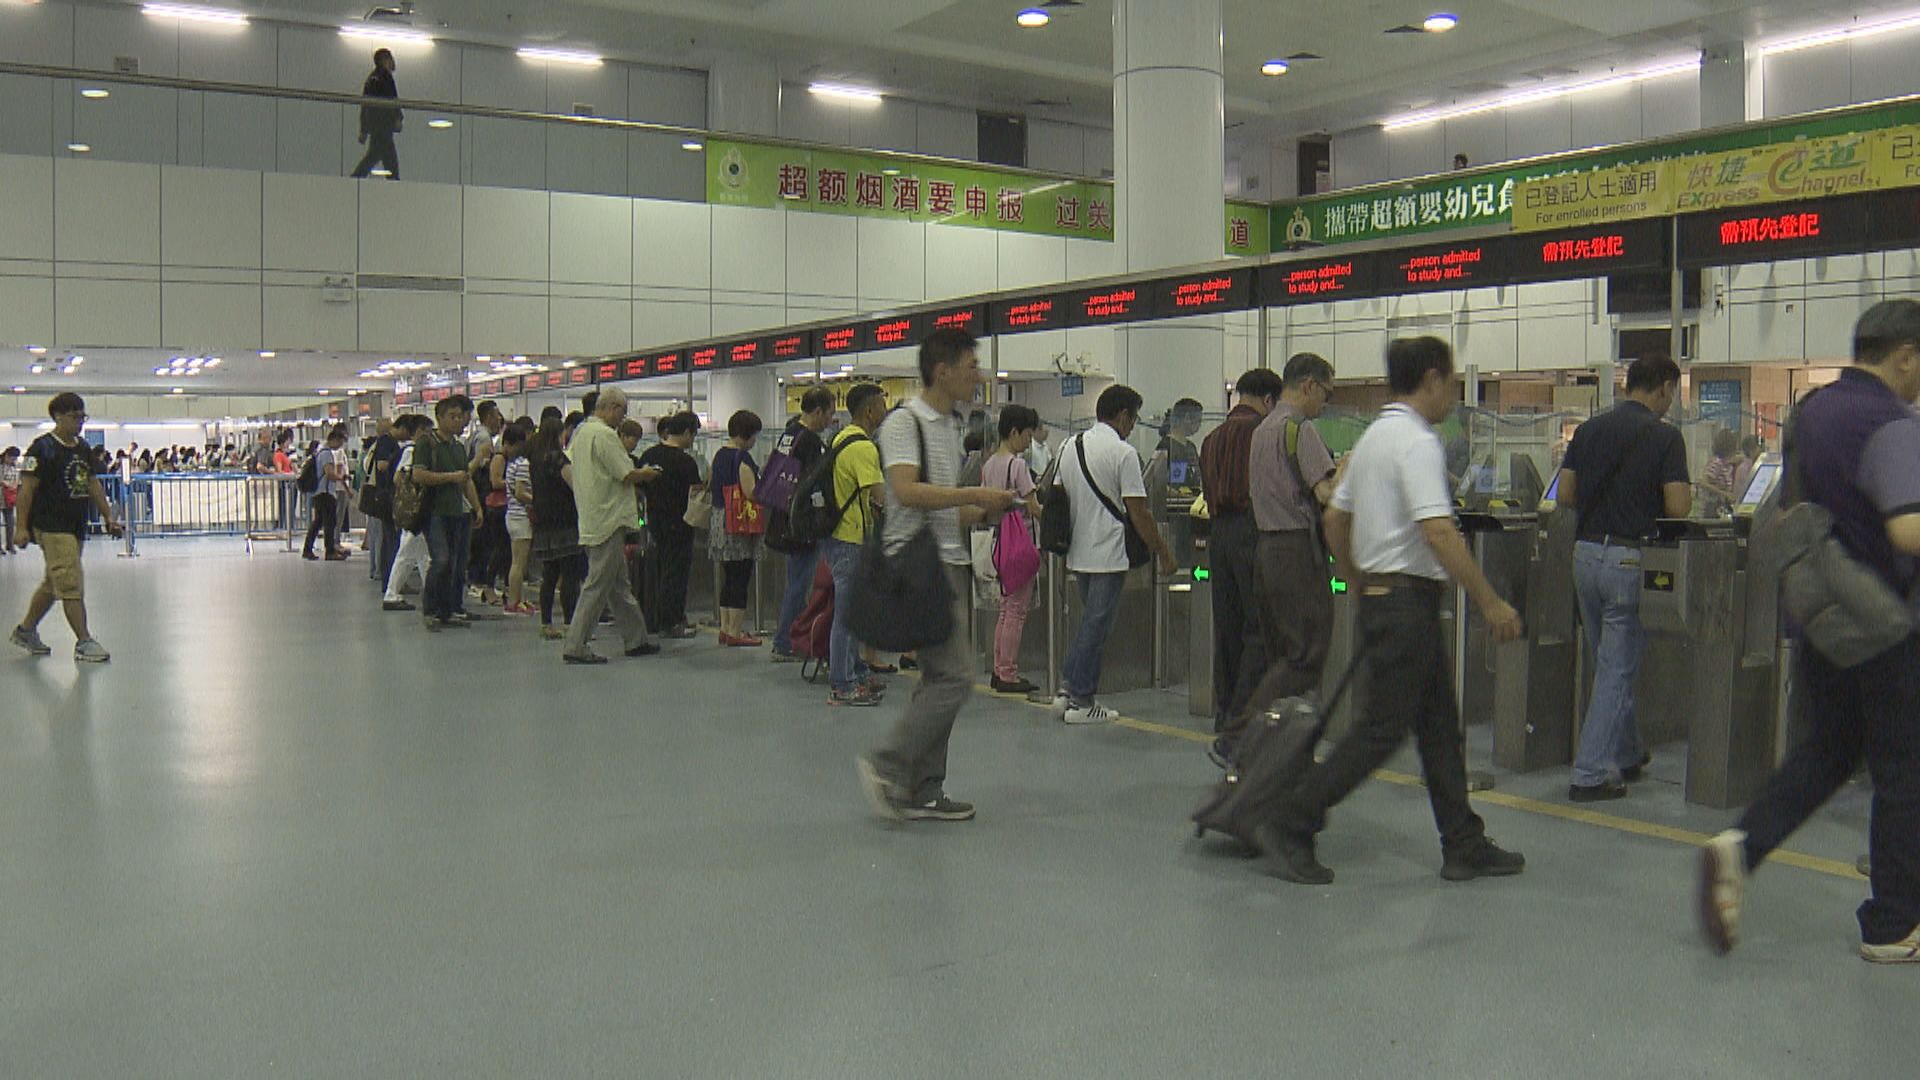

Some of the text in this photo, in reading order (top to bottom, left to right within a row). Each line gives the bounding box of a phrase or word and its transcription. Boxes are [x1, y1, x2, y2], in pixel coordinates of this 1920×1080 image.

[1892, 135, 1920, 160] 已
[1688, 156, 1747, 190] 快捷
[1525, 170, 1657, 209] 已登記人士適用
[778, 163, 1250, 248] 超额烟酒要申报 过关 道
[1536, 201, 1647, 224] For enrolled persons
[1442, 248, 1480, 265] admitted
[1318, 261, 1352, 278] admitted
[1408, 269, 1417, 282] to
[1419, 268, 1442, 282] study
[1289, 282, 1297, 294] to
[1298, 280, 1318, 293] study
